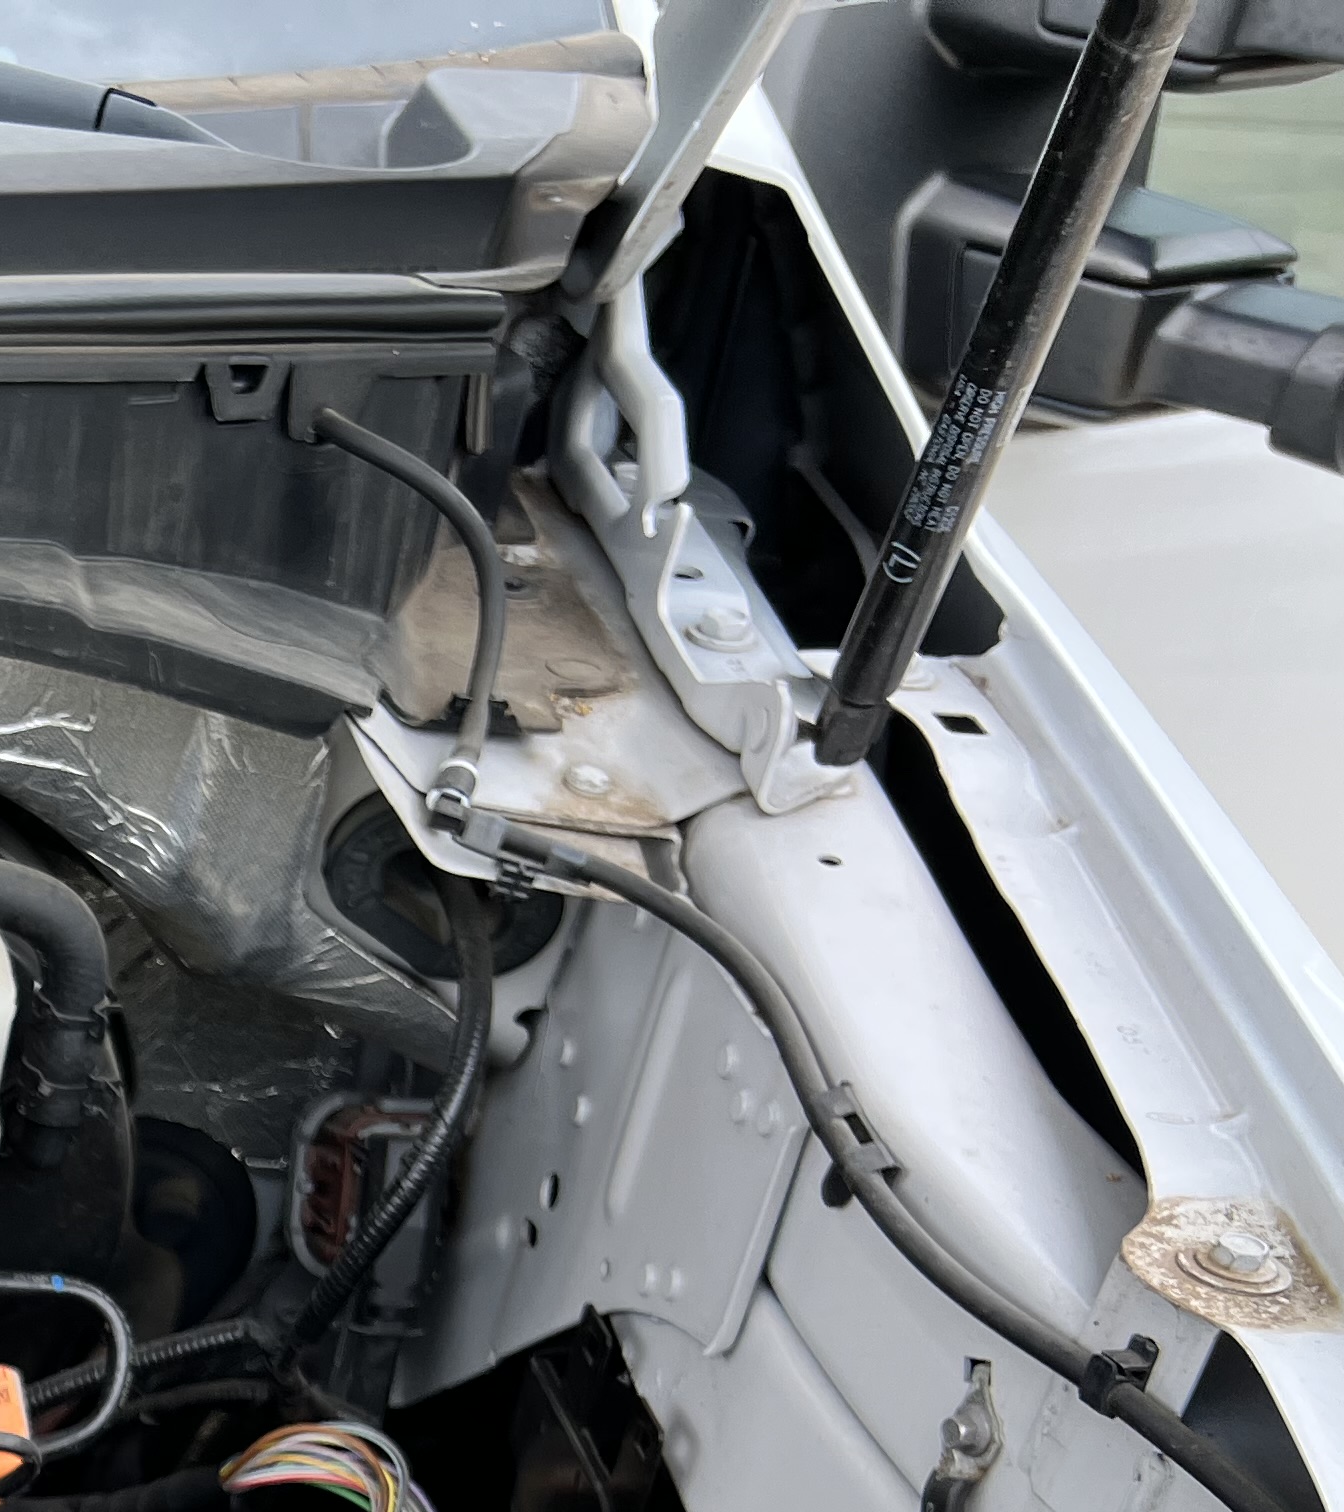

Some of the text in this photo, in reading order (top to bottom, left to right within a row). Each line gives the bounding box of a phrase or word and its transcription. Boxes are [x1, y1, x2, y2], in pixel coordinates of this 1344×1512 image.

[975, 387, 992, 405] DO
[966, 406, 984, 428] NOT
[944, 464, 960, 481] DO
[935, 482, 952, 503] NOT
[883, 541, 922, 583] (L)
